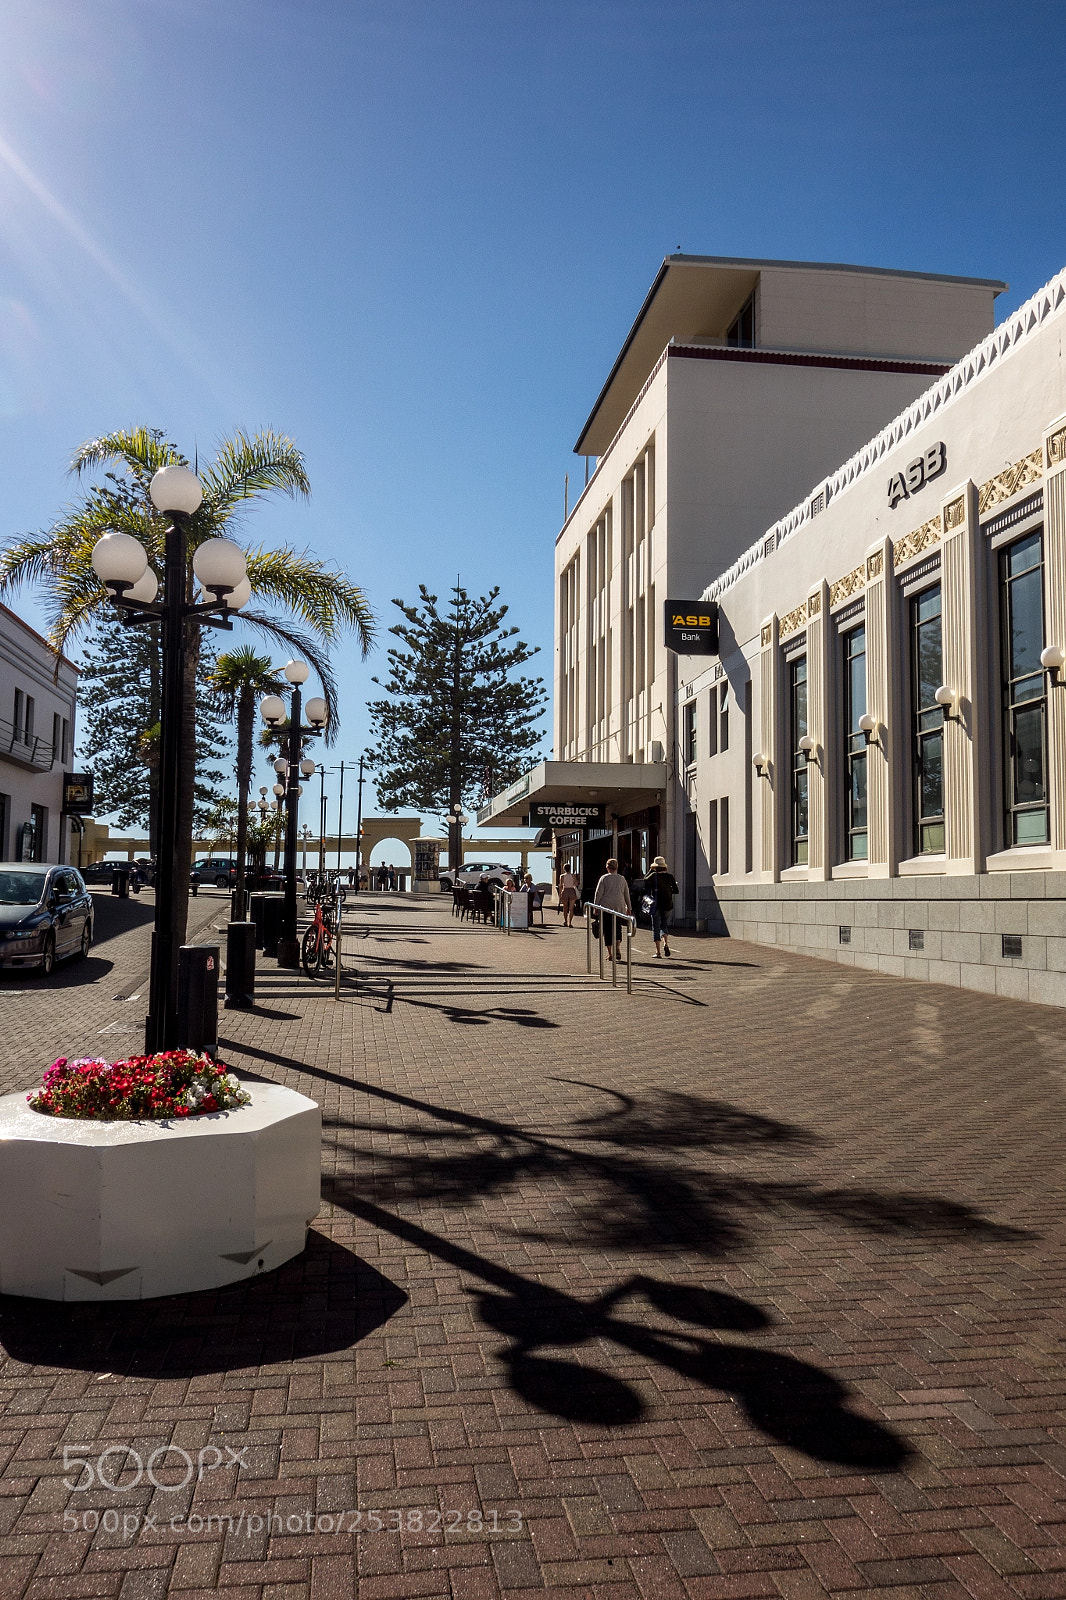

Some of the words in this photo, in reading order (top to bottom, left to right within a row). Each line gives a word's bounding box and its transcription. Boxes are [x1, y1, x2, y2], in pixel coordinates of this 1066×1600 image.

[887, 441, 946, 508] ASB
[672, 615, 711, 626] ASB
[681, 632, 701, 641] Bank
[537, 806, 599, 816] STARBUCKS
[548, 816, 587, 825] COFFEE
